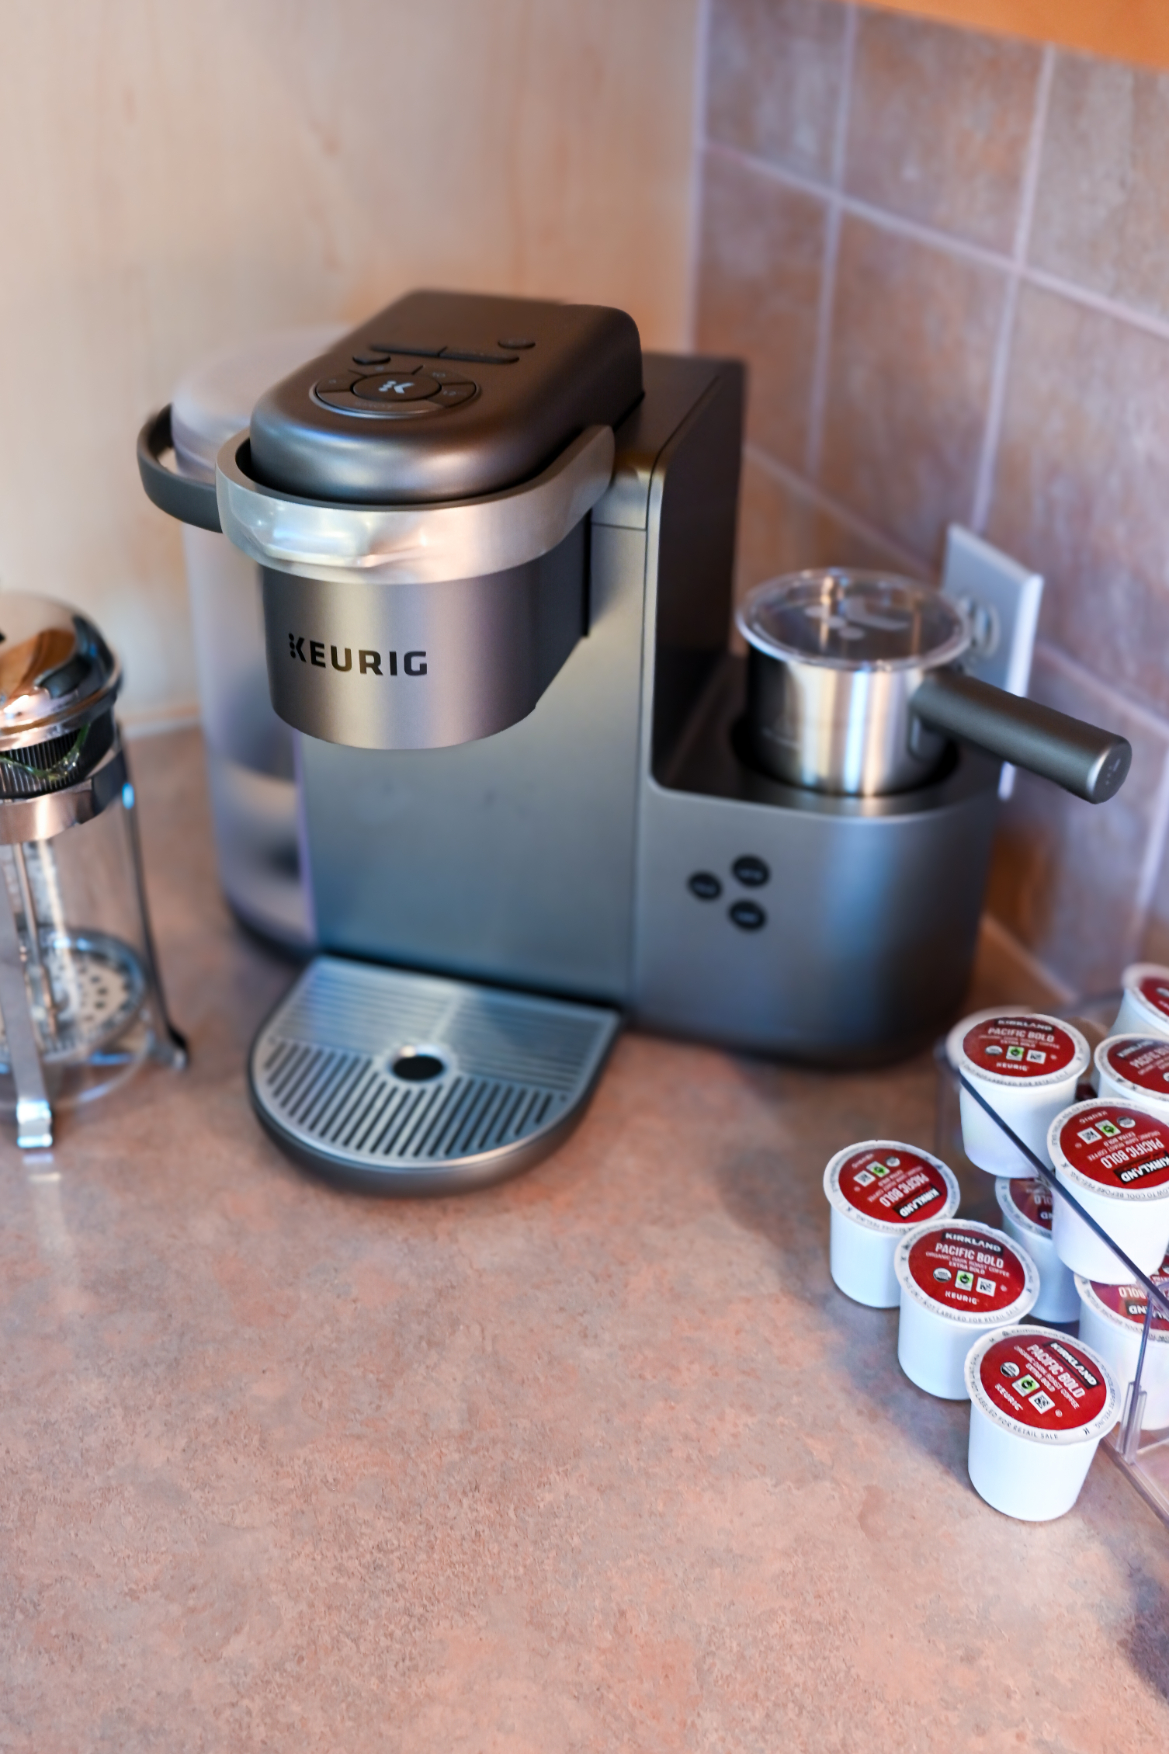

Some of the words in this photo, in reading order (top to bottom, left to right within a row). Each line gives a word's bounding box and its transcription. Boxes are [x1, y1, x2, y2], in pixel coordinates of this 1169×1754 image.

[288, 633, 427, 676] KEURIG
[988, 1028, 1026, 1037] PACIFIC
[1028, 1032, 1054, 1042] BOLD
[996, 1062, 1028, 1072] KEURIG
[1126, 1138, 1164, 1158] PACIFIC
[1101, 1150, 1129, 1169] BOLD
[1121, 1154, 1169, 1182] KIRKLAND
[898, 1173, 929, 1194] PACIFIC
[879, 1188, 904, 1207] BOLD
[899, 1188, 940, 1217] KIRKLAND
[945, 1232, 1002, 1252] KIRKLAND
[935, 1243, 975, 1260] PACIFIC
[976, 1252, 1004, 1268] BOLD
[945, 1291, 977, 1305] KEURIG
[1027, 1344, 1064, 1375] PACIFIC
[1058, 1372, 1085, 1398] BOLD
[1050, 1342, 1097, 1386] KIRKLAND
[995, 1383, 1021, 1411] KEURIG
[1013, 1425, 1037, 1438] RETAIL
